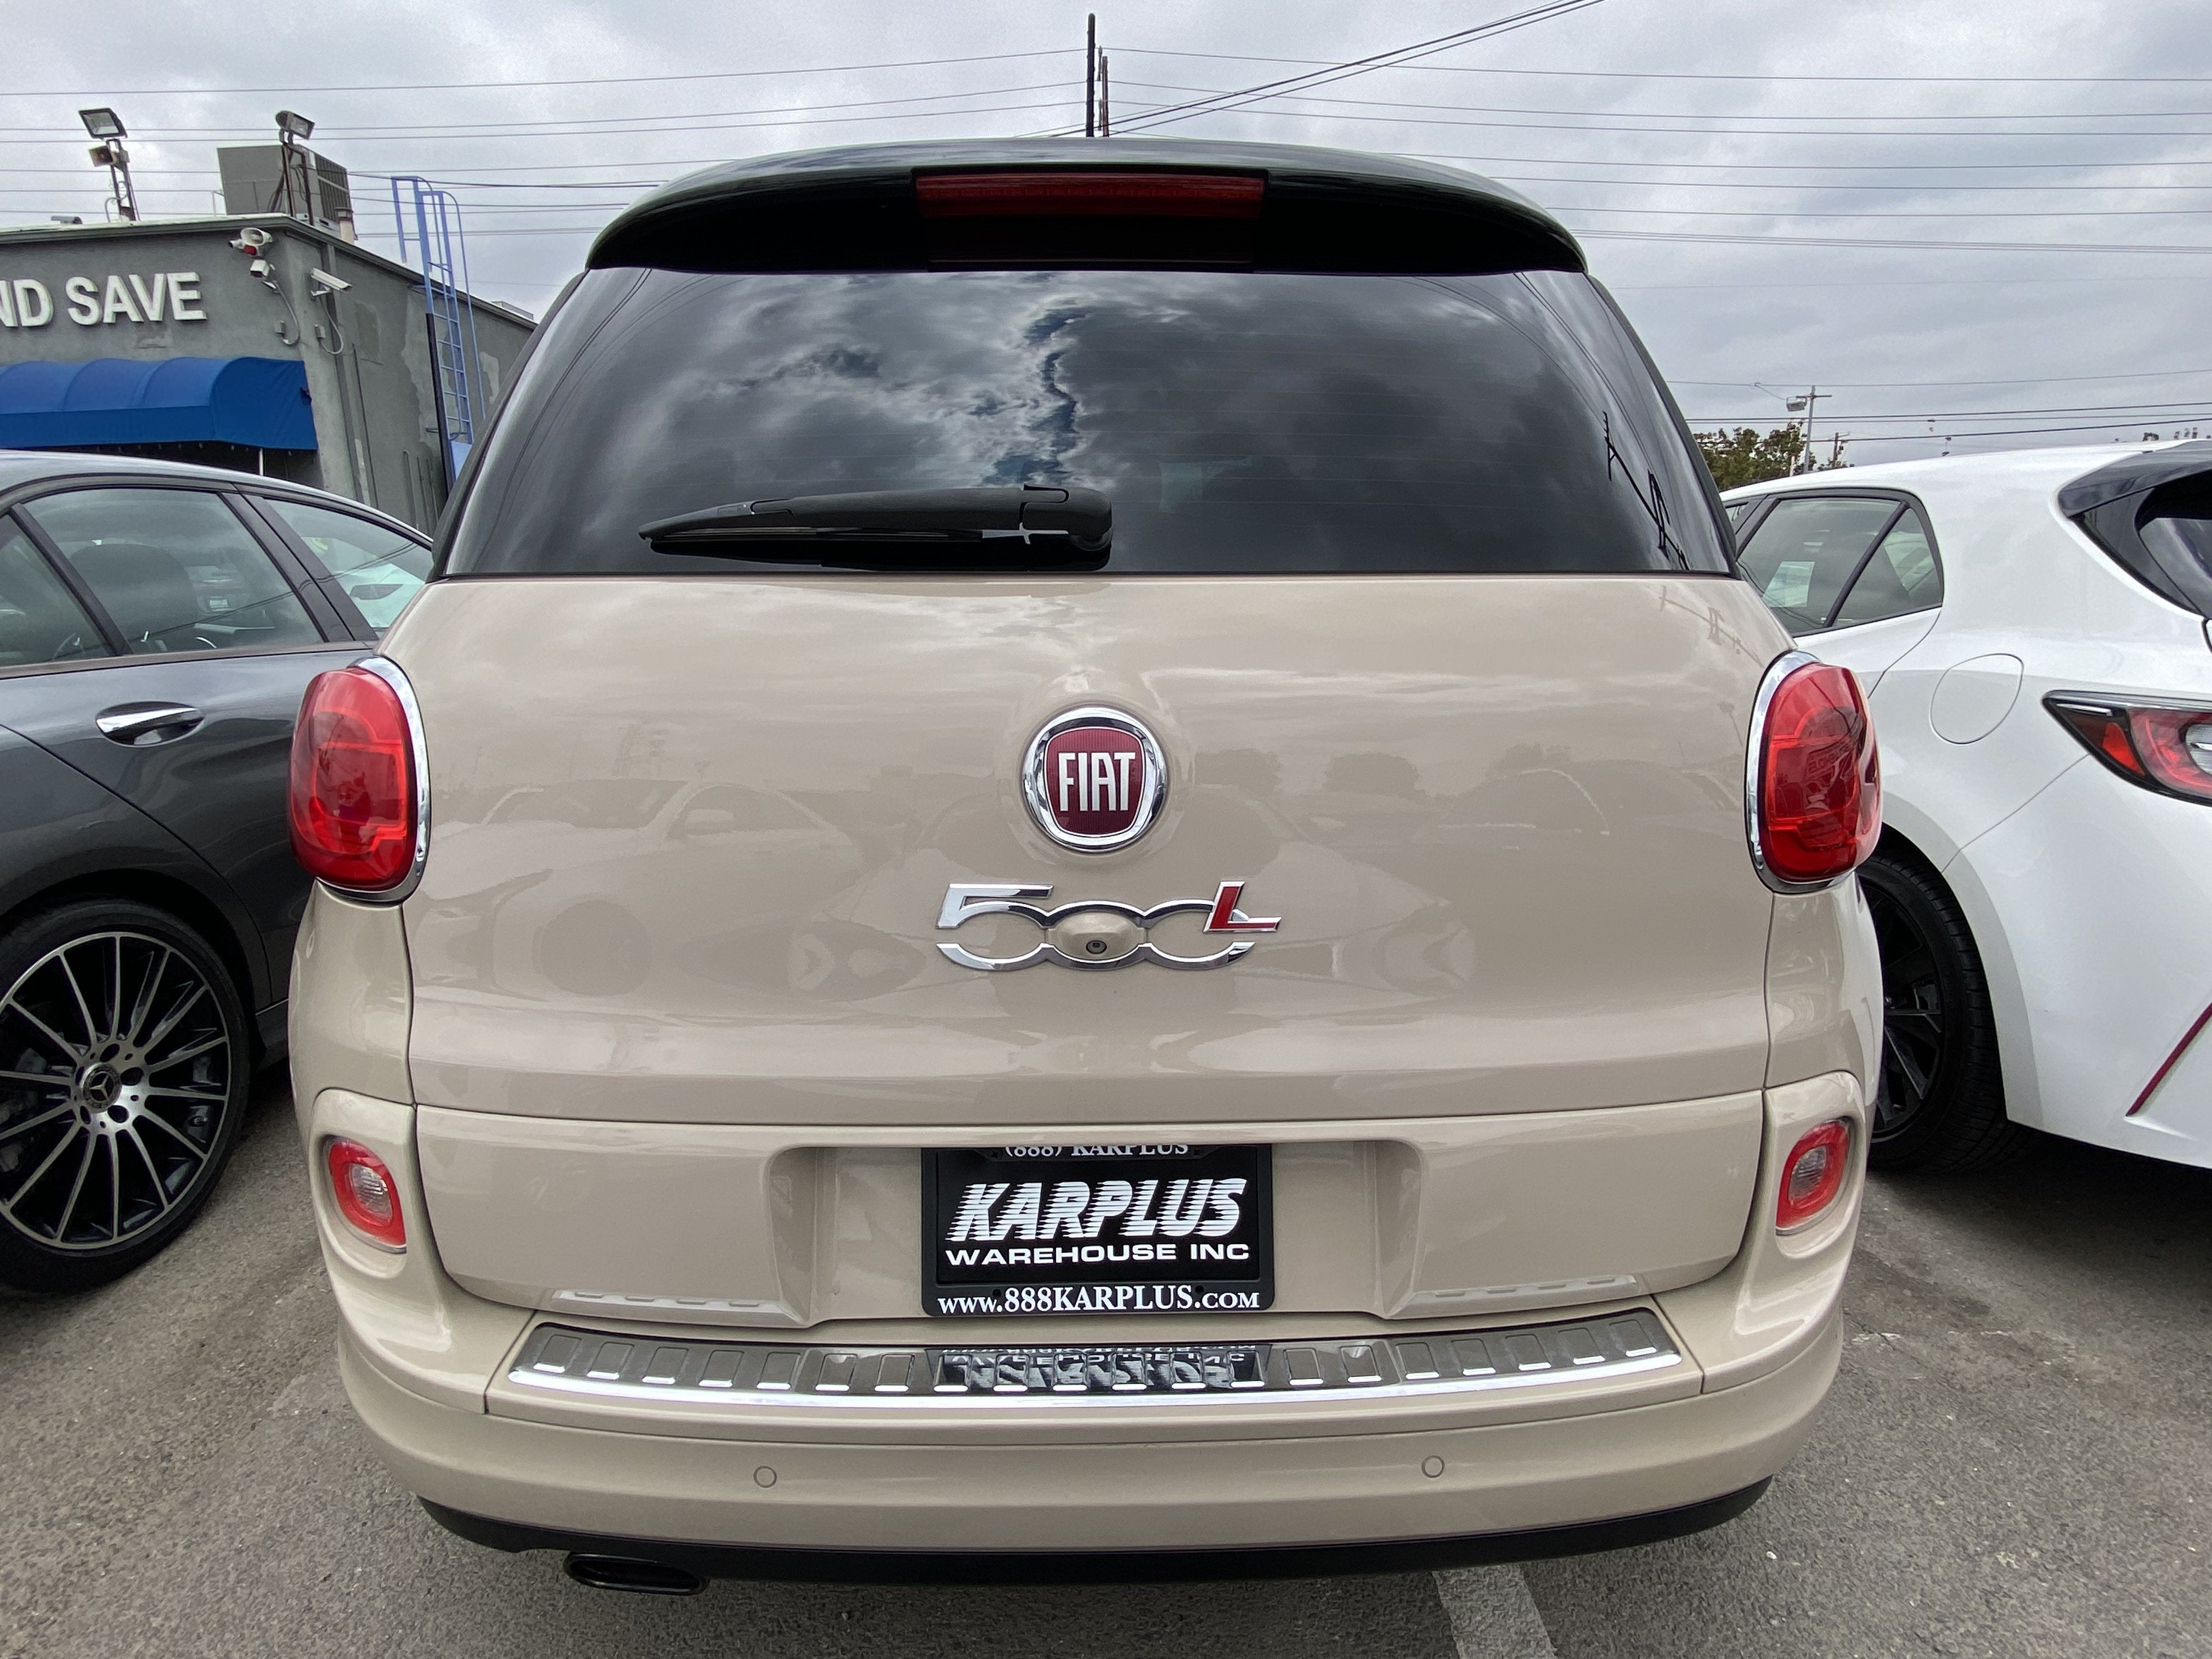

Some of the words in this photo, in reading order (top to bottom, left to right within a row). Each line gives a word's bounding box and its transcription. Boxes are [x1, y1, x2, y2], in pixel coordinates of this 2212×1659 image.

[65, 272, 208, 325] SAVE
[1058, 752, 1136, 811] FIAT
[945, 1178, 1247, 1242] KARPLUS
[945, 1244, 1176, 1265] WAREHOUSE
[1190, 1243, 1249, 1260] INC
